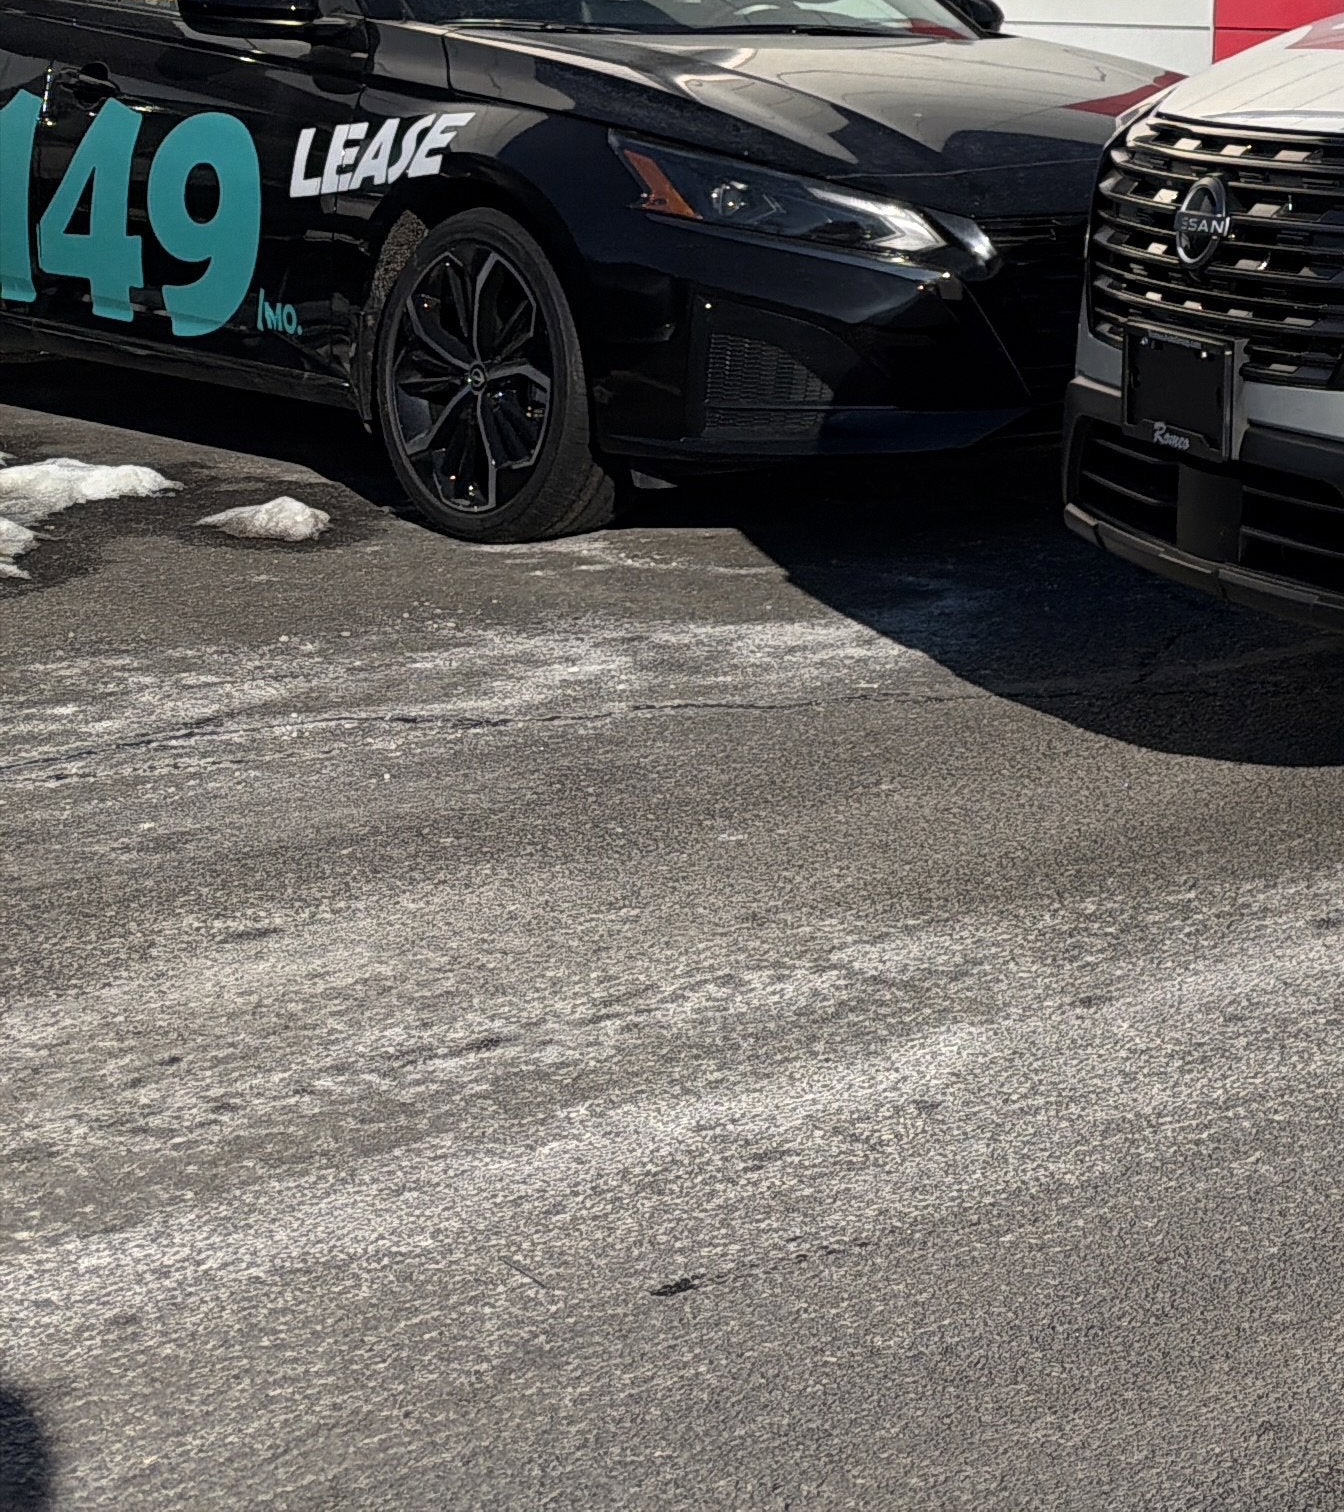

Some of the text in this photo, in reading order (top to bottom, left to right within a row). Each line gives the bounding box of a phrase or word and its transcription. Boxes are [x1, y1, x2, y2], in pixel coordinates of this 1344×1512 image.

[290, 111, 476, 198] LEASE
[0, 89, 262, 337] 149
[1153, 421, 1190, 450] Romeo
